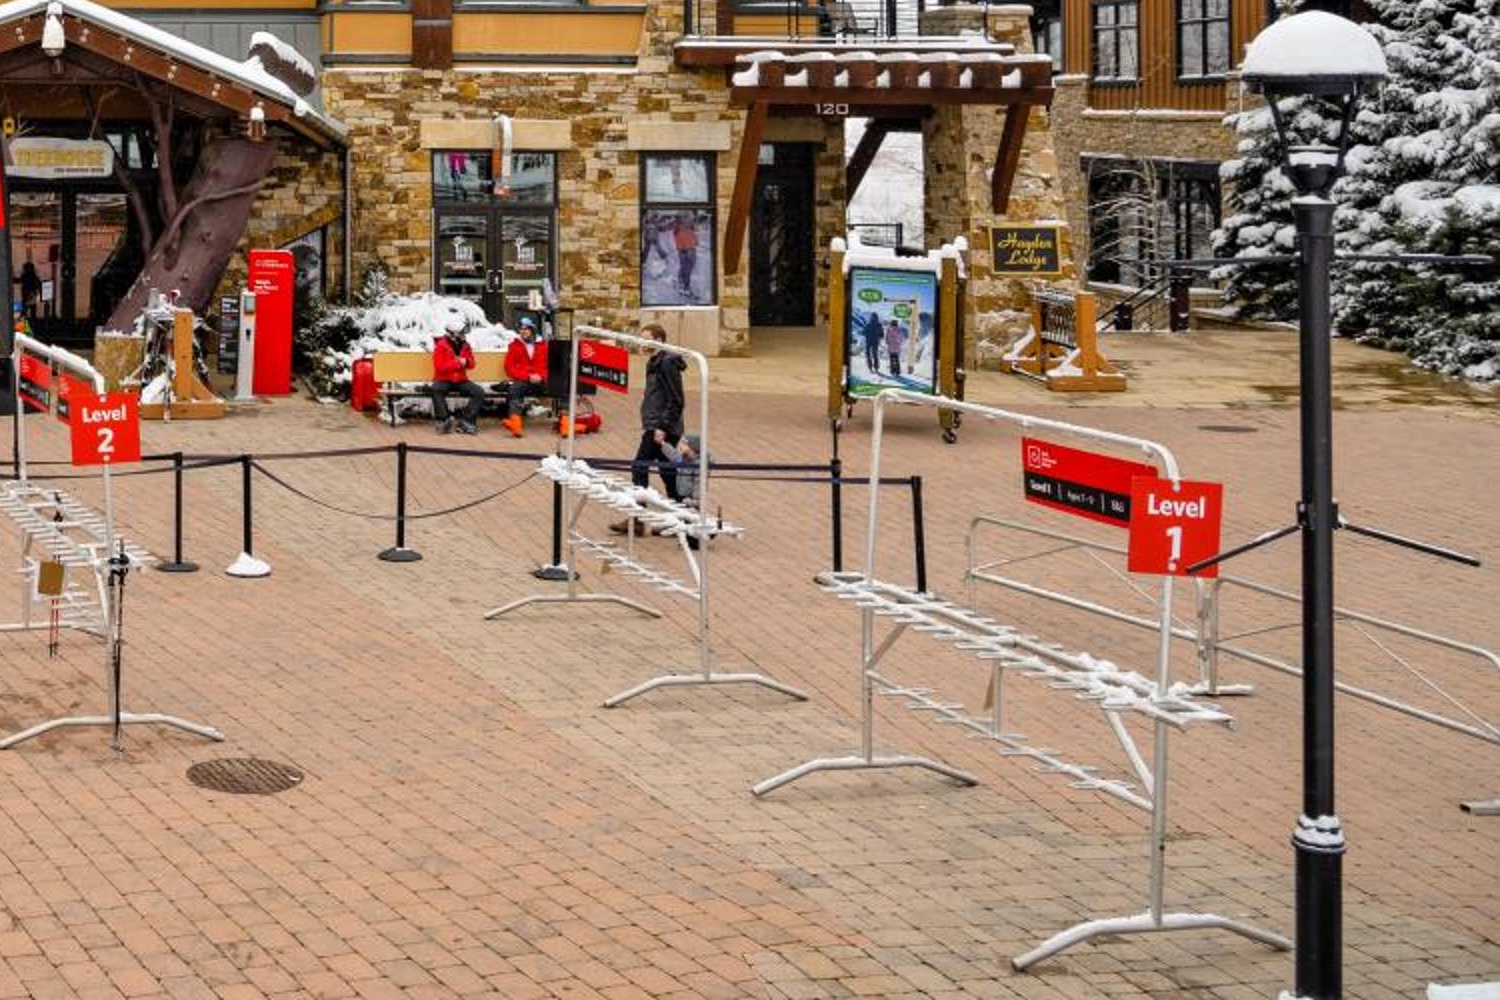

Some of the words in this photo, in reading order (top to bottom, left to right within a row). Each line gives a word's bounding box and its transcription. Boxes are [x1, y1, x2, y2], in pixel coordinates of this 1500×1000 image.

[815, 103, 849, 115] 120
[998, 232, 1053, 251] Hayden
[1004, 249, 1047, 270] Lodge
[82, 404, 127, 423] Level
[97, 427, 115, 453] 2
[1148, 493, 1206, 519] Level
[1166, 525, 1183, 560] 1
